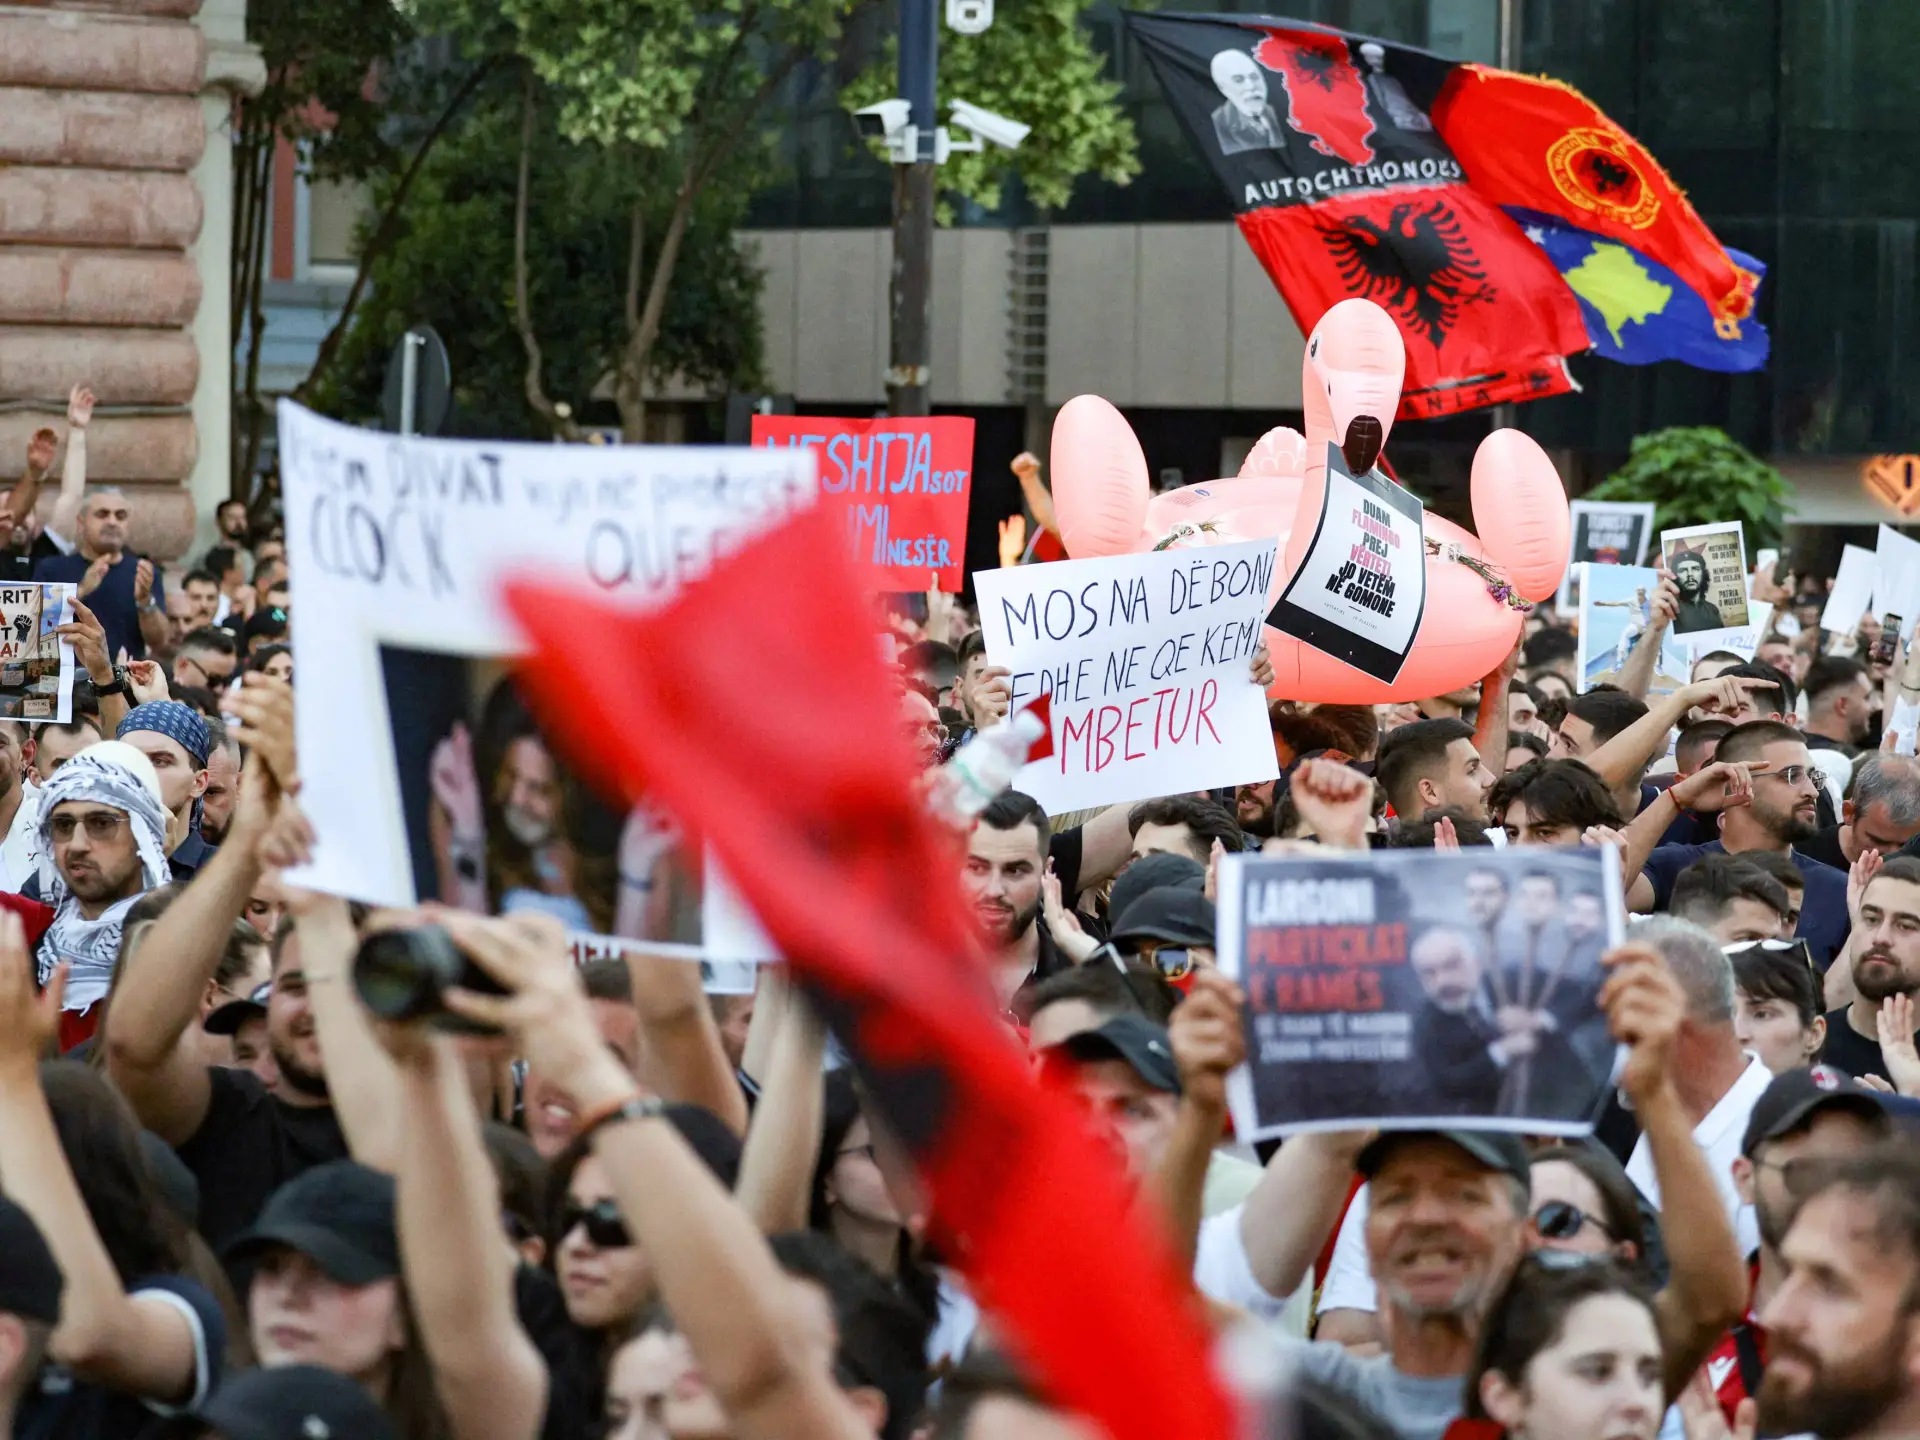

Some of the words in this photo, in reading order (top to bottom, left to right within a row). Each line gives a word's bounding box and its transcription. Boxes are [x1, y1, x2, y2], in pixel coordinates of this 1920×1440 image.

[930, 470, 968, 494] SOT
[1363, 498, 1391, 528] DUAM
[1352, 508, 1401, 550] FLAMINGO
[1362, 531, 1389, 559] PREJ
[1338, 560, 1357, 580] JO
[0, 589, 32, 605] RIT
[1001, 581, 1099, 647] MOS
[1109, 575, 1150, 627] NA
[1170, 547, 1277, 615] DËBONI
[1344, 582, 1396, 618] GOMONE
[1718, 589, 1739, 598] PATRIA
[1104, 646, 1147, 697] NE
[1150, 633, 1196, 680] QE
[1200, 609, 1264, 667] KEMI
[1061, 678, 1222, 775] MBETUR
